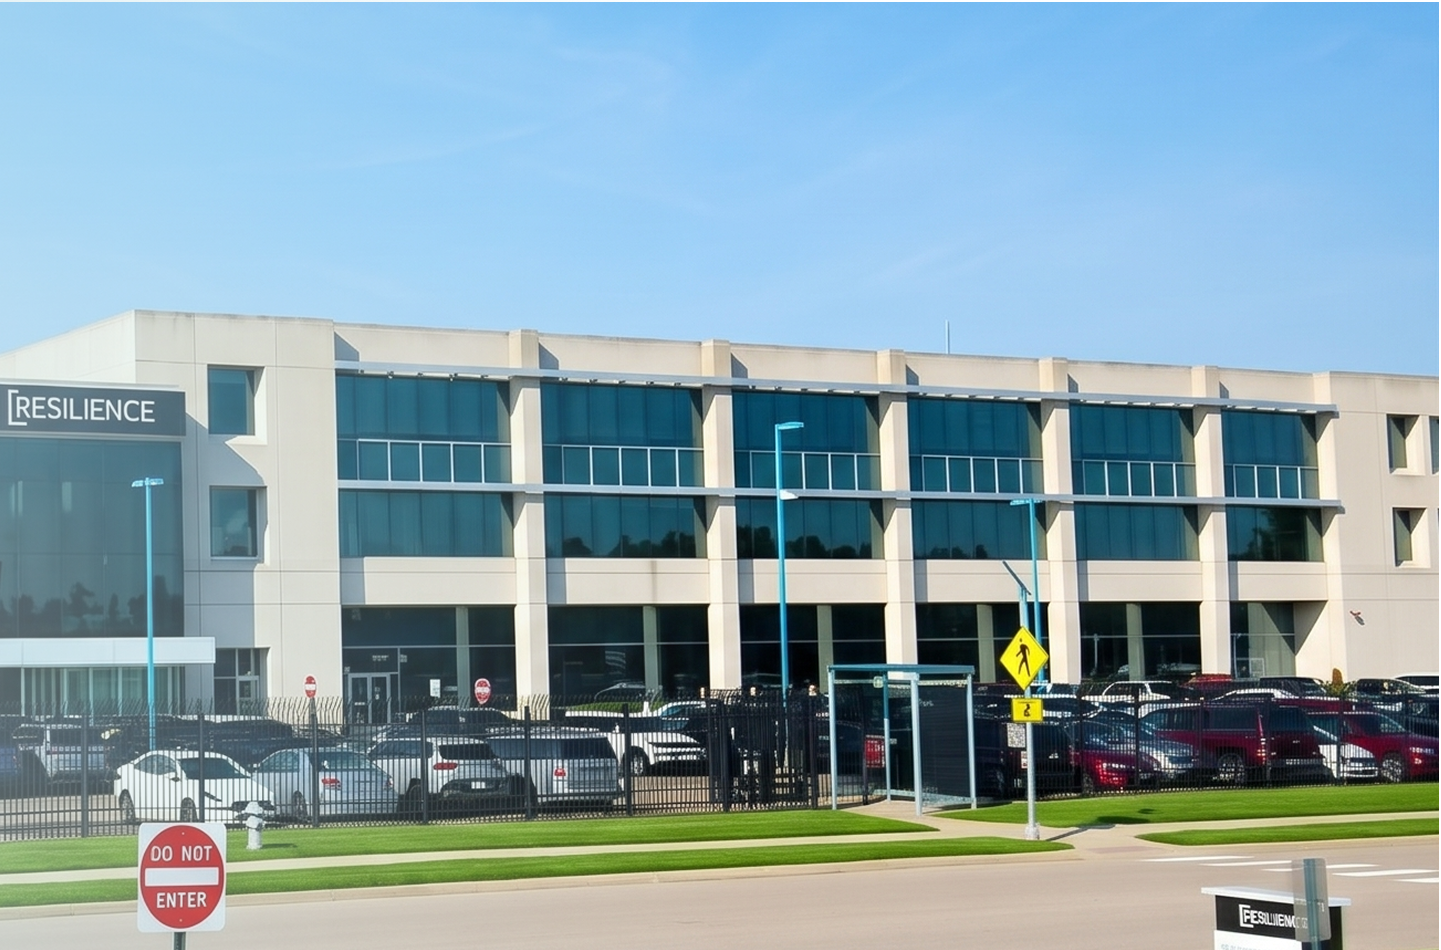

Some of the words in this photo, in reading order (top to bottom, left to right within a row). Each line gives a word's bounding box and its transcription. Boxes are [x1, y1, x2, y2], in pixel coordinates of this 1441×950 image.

[15, 395, 156, 423] RESILIENCE
[150, 845, 173, 861] DO
[181, 845, 213, 861] NOT
[156, 891, 207, 908] ENTER
